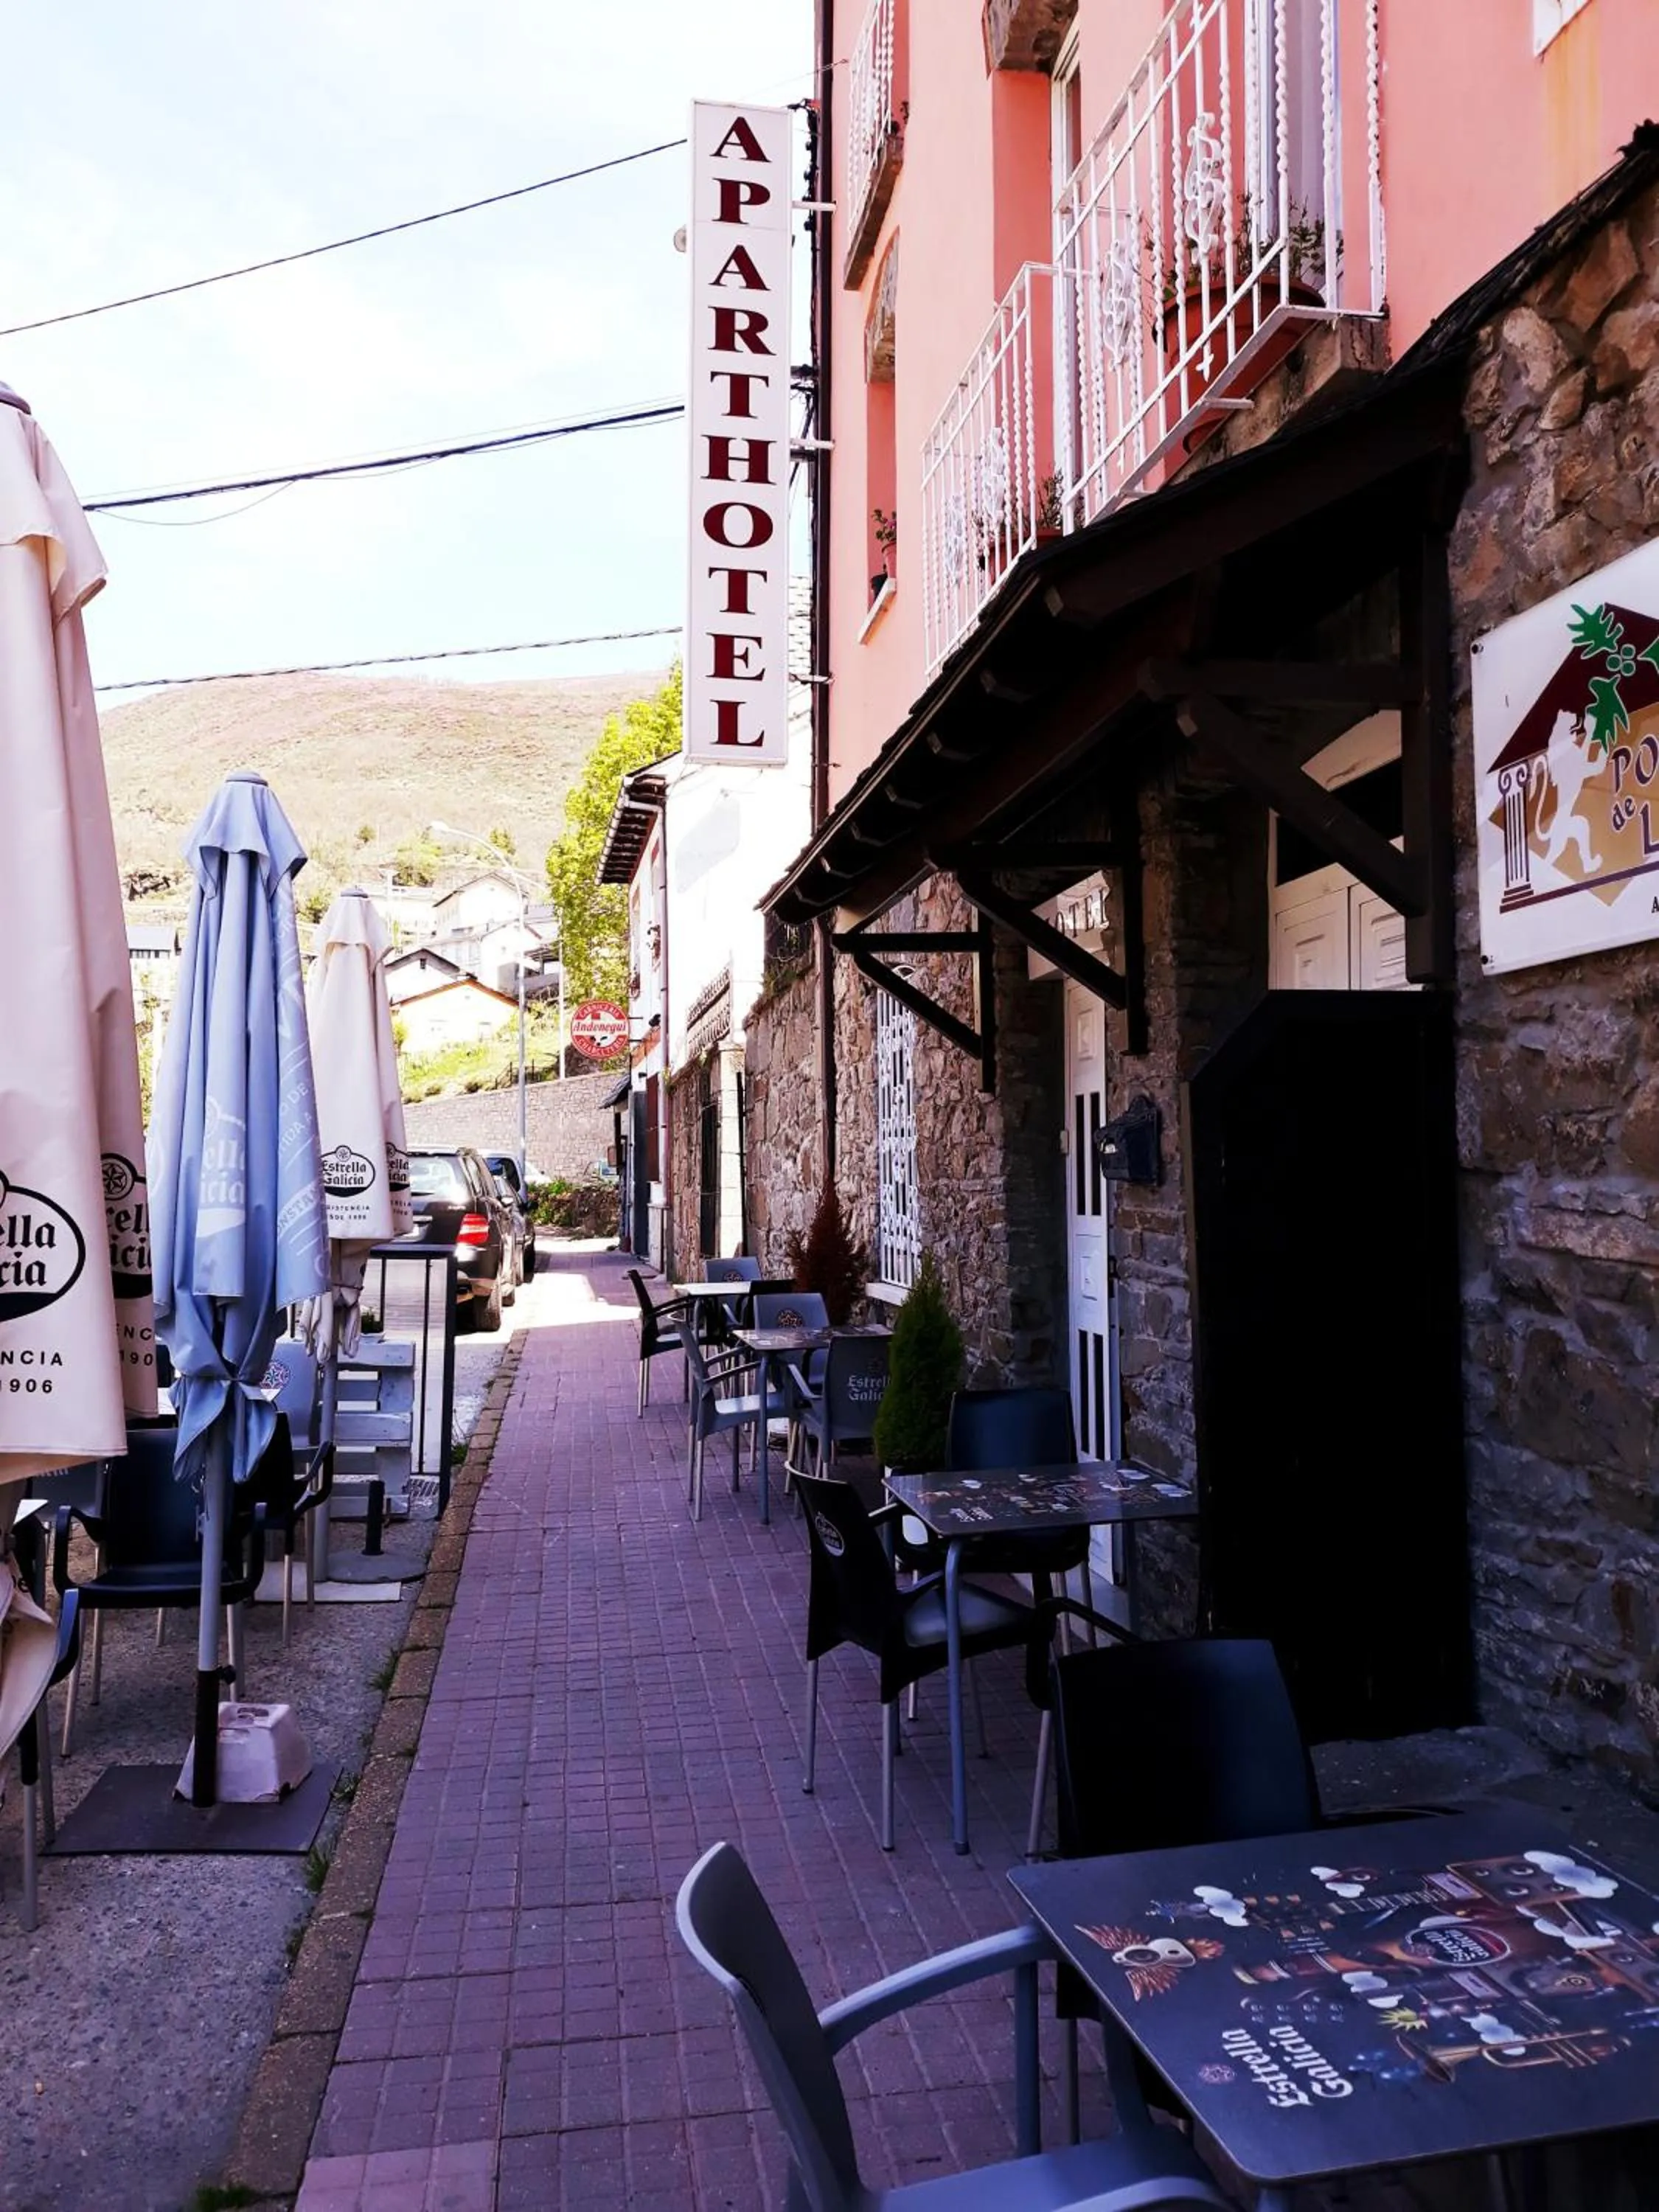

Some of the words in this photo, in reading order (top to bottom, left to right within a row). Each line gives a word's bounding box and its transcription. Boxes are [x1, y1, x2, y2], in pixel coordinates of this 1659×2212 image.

[701, 116, 777, 748] APARTHOTEL
[1613, 798, 1635, 831] de
[1222, 2028, 1314, 2108] Estrella
[1268, 2025, 1354, 2098] Galicia
